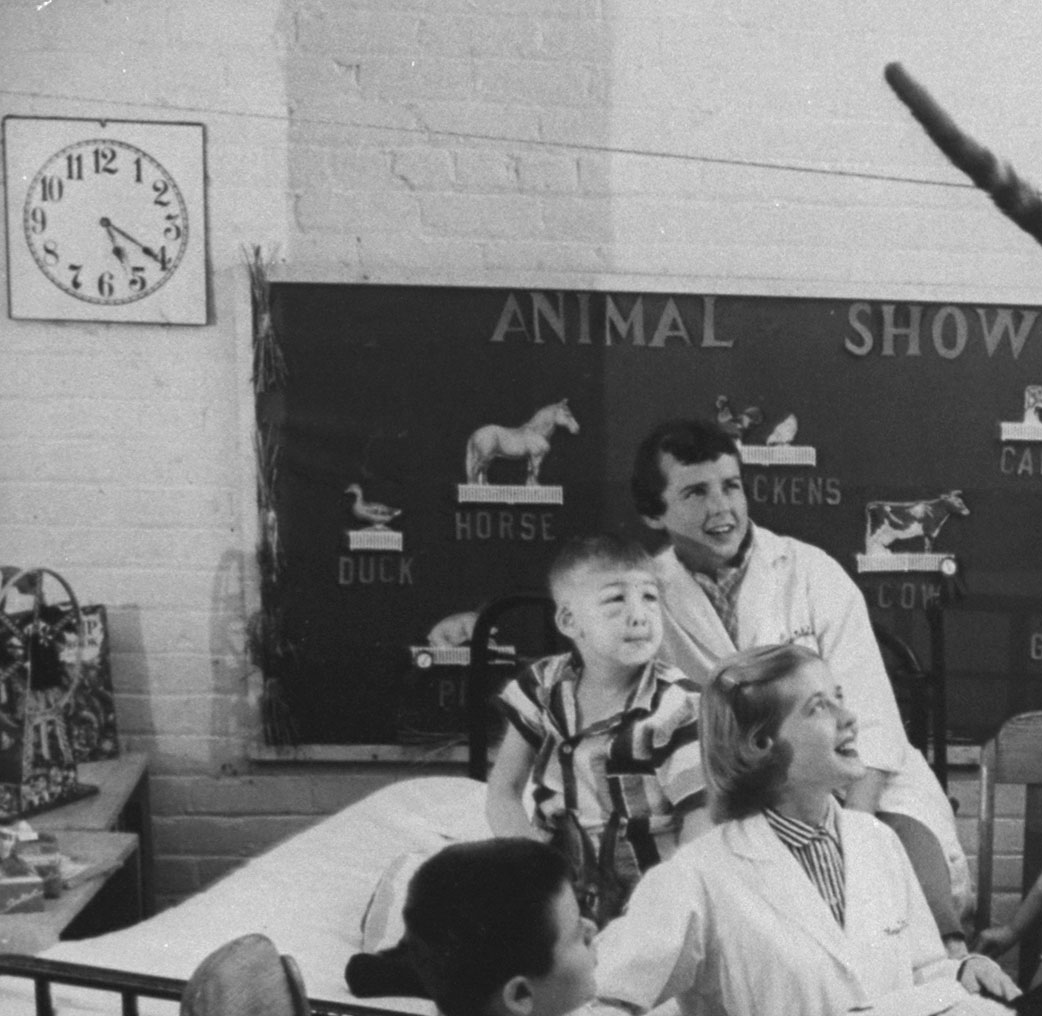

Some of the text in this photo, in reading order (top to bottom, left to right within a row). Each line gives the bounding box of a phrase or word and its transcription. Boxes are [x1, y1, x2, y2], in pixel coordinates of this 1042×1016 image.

[66, 154, 83, 180] 11
[93, 147, 118, 175] 12
[134, 157, 143, 183] 1
[41, 175, 64, 202] 10
[152, 179, 171, 207] 2
[31, 207, 47, 235] 9
[164, 213, 182, 241] 3
[43, 241, 59, 267] 8
[155, 245, 172, 271] 4
[68, 264, 83, 290] 7
[98, 271, 114, 298] 6
[129, 266, 146, 292] 5
[489, 291, 1041, 360] ANIMAL SHOW
[753, 475, 842, 506] CKENS
[455, 512, 556, 542] HORSE
[338, 556, 414, 586] DUCK
[439, 680, 466, 707] PI
